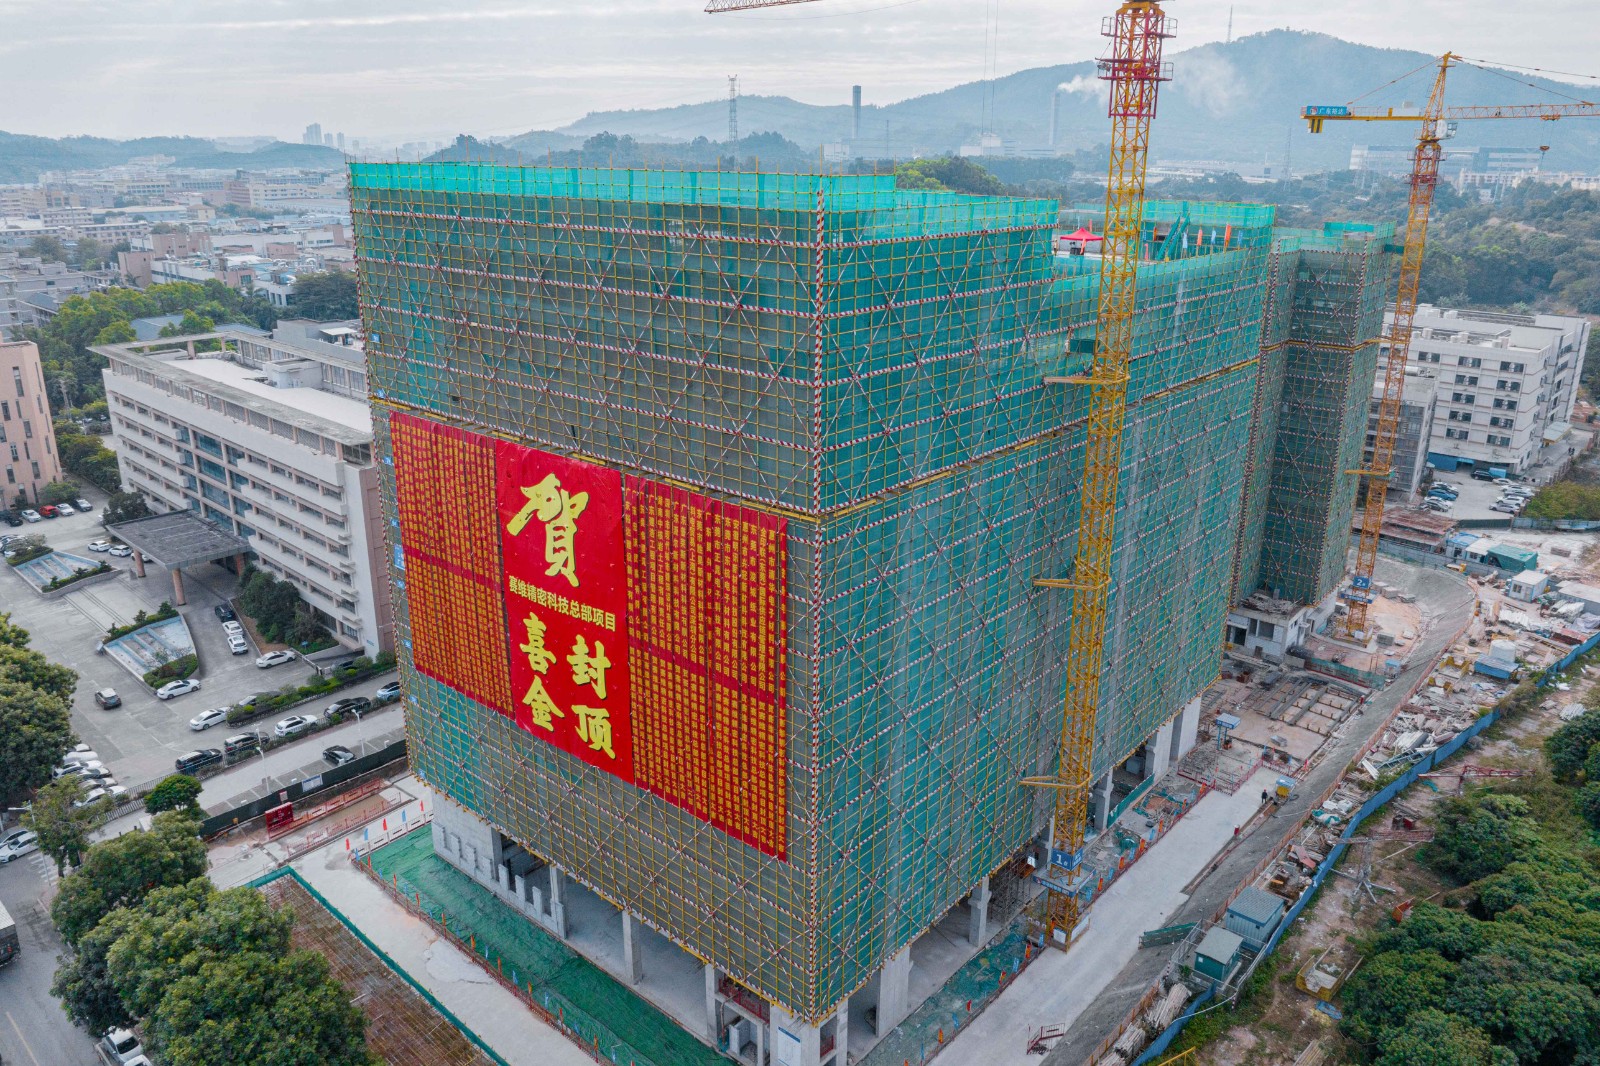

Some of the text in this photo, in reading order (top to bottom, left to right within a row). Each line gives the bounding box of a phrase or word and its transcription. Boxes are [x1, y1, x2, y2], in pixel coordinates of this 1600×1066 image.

[506, 473, 589, 588] 贺
[508, 575, 616, 632] 赛维精密科技总部项目
